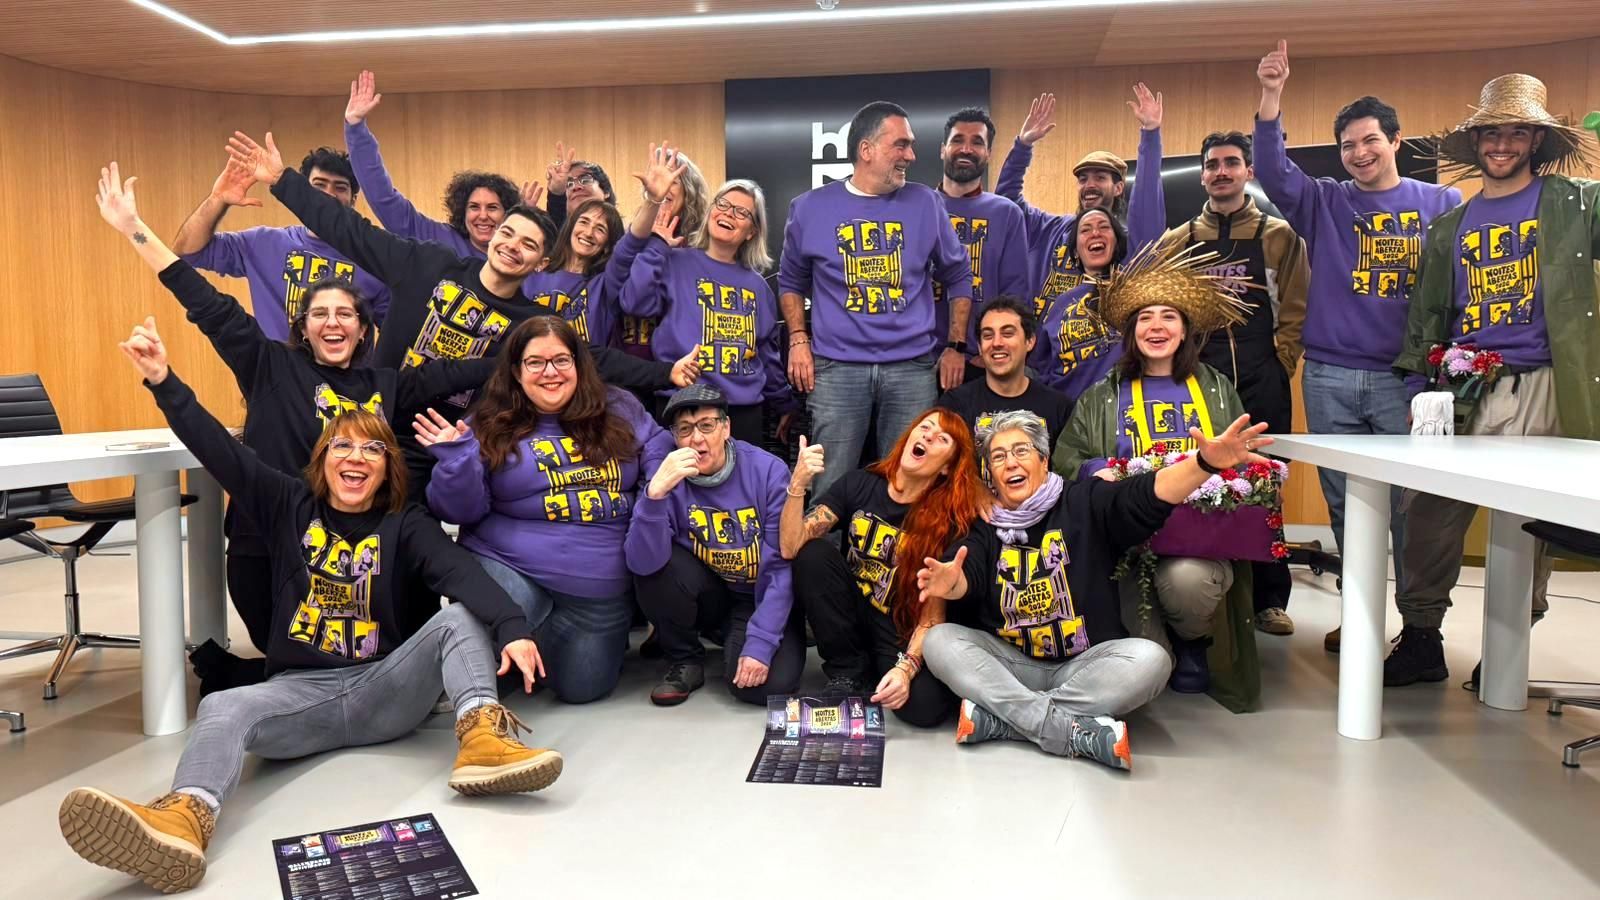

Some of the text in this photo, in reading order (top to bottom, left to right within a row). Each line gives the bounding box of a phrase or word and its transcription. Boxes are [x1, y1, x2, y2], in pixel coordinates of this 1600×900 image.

[1375, 239, 1405, 247] NOITES
[1375, 246, 1406, 254] ABERTAS
[860, 258, 885, 267] NOITES
[860, 266, 887, 274] ABERTAS
[1485, 264, 1516, 278] NOITES
[1487, 272, 1518, 286] ABERTAS
[717, 315, 742, 325] NOITES
[439, 328, 470, 346] NOITES
[435, 335, 467, 353] ABERTAS
[569, 467, 602, 484] NOITES
[711, 551, 742, 560] NOITES
[711, 559, 744, 567] ABERTAS
[314, 577, 348, 594] NOITES
[313, 586, 350, 601] ABERTAS
[1018, 591, 1052, 608] ABERTAS
[1028, 601, 1047, 611] 2026
[814, 709, 836, 717] NOITES
